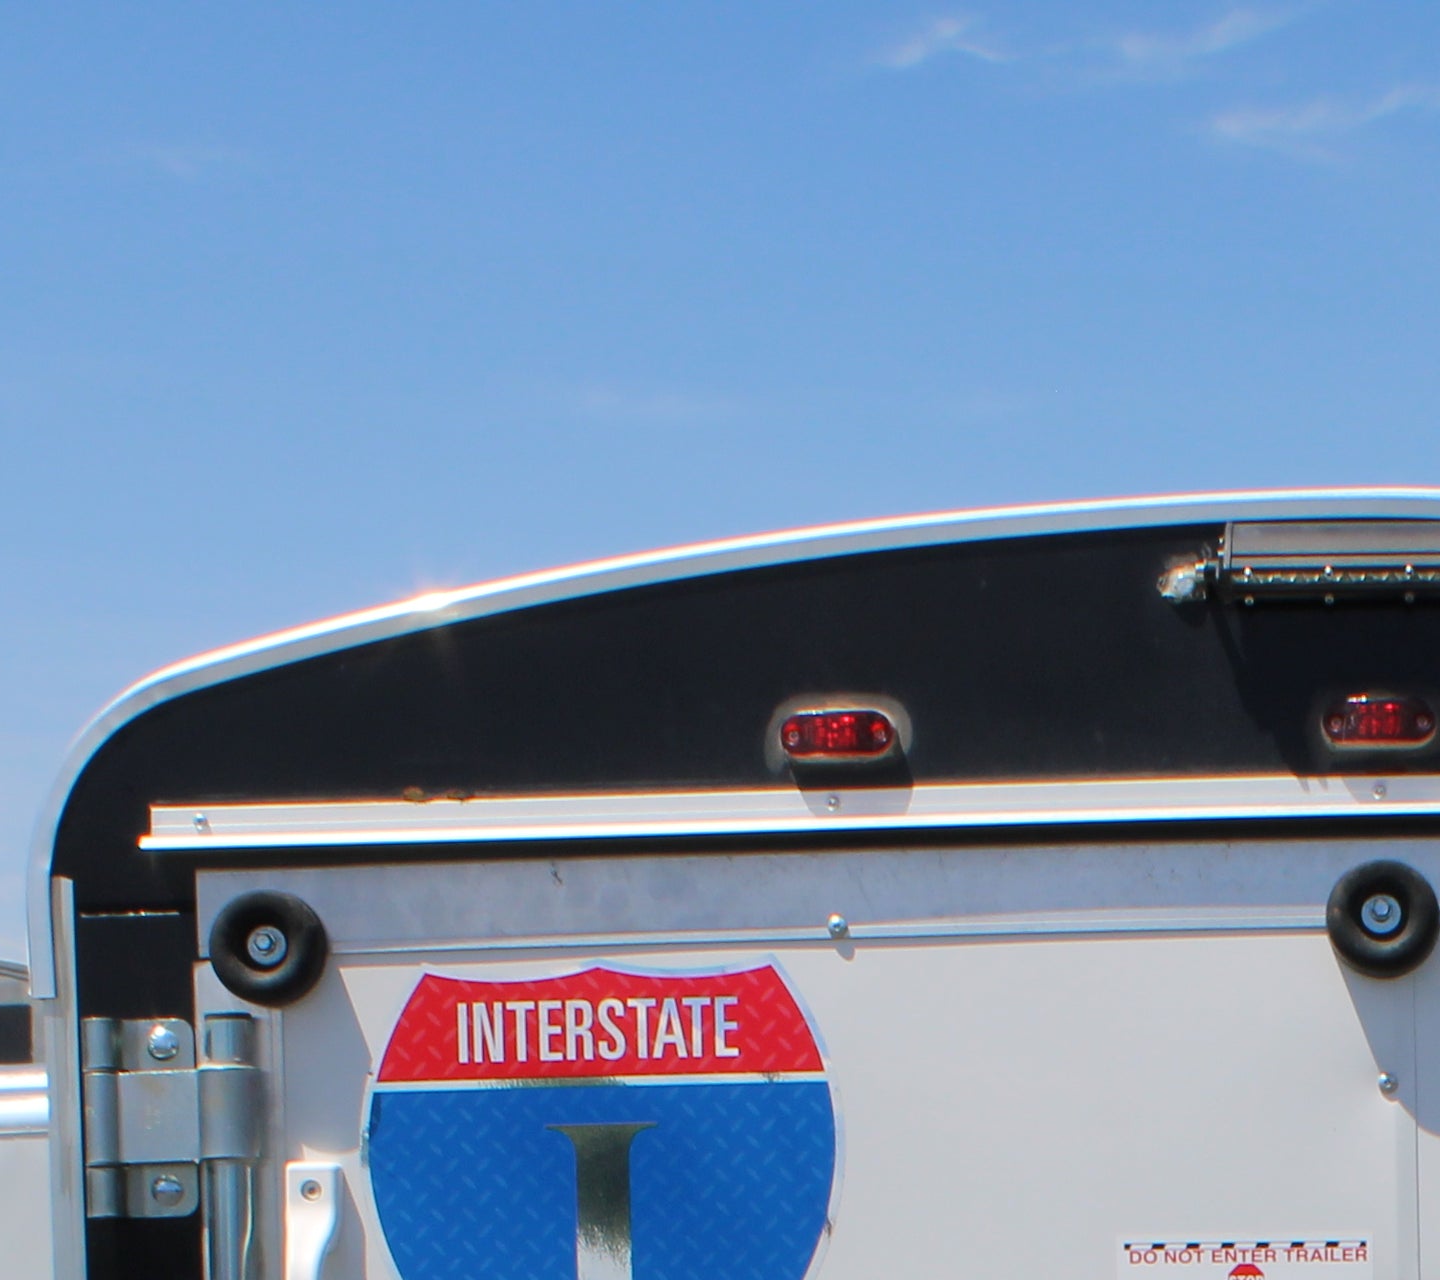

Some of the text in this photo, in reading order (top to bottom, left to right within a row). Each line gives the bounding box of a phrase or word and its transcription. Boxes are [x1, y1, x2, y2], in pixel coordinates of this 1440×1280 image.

[456, 996, 740, 1065] INTERSTATE
[1129, 1247, 1368, 1265] DO NOT ENTER TRAILER
